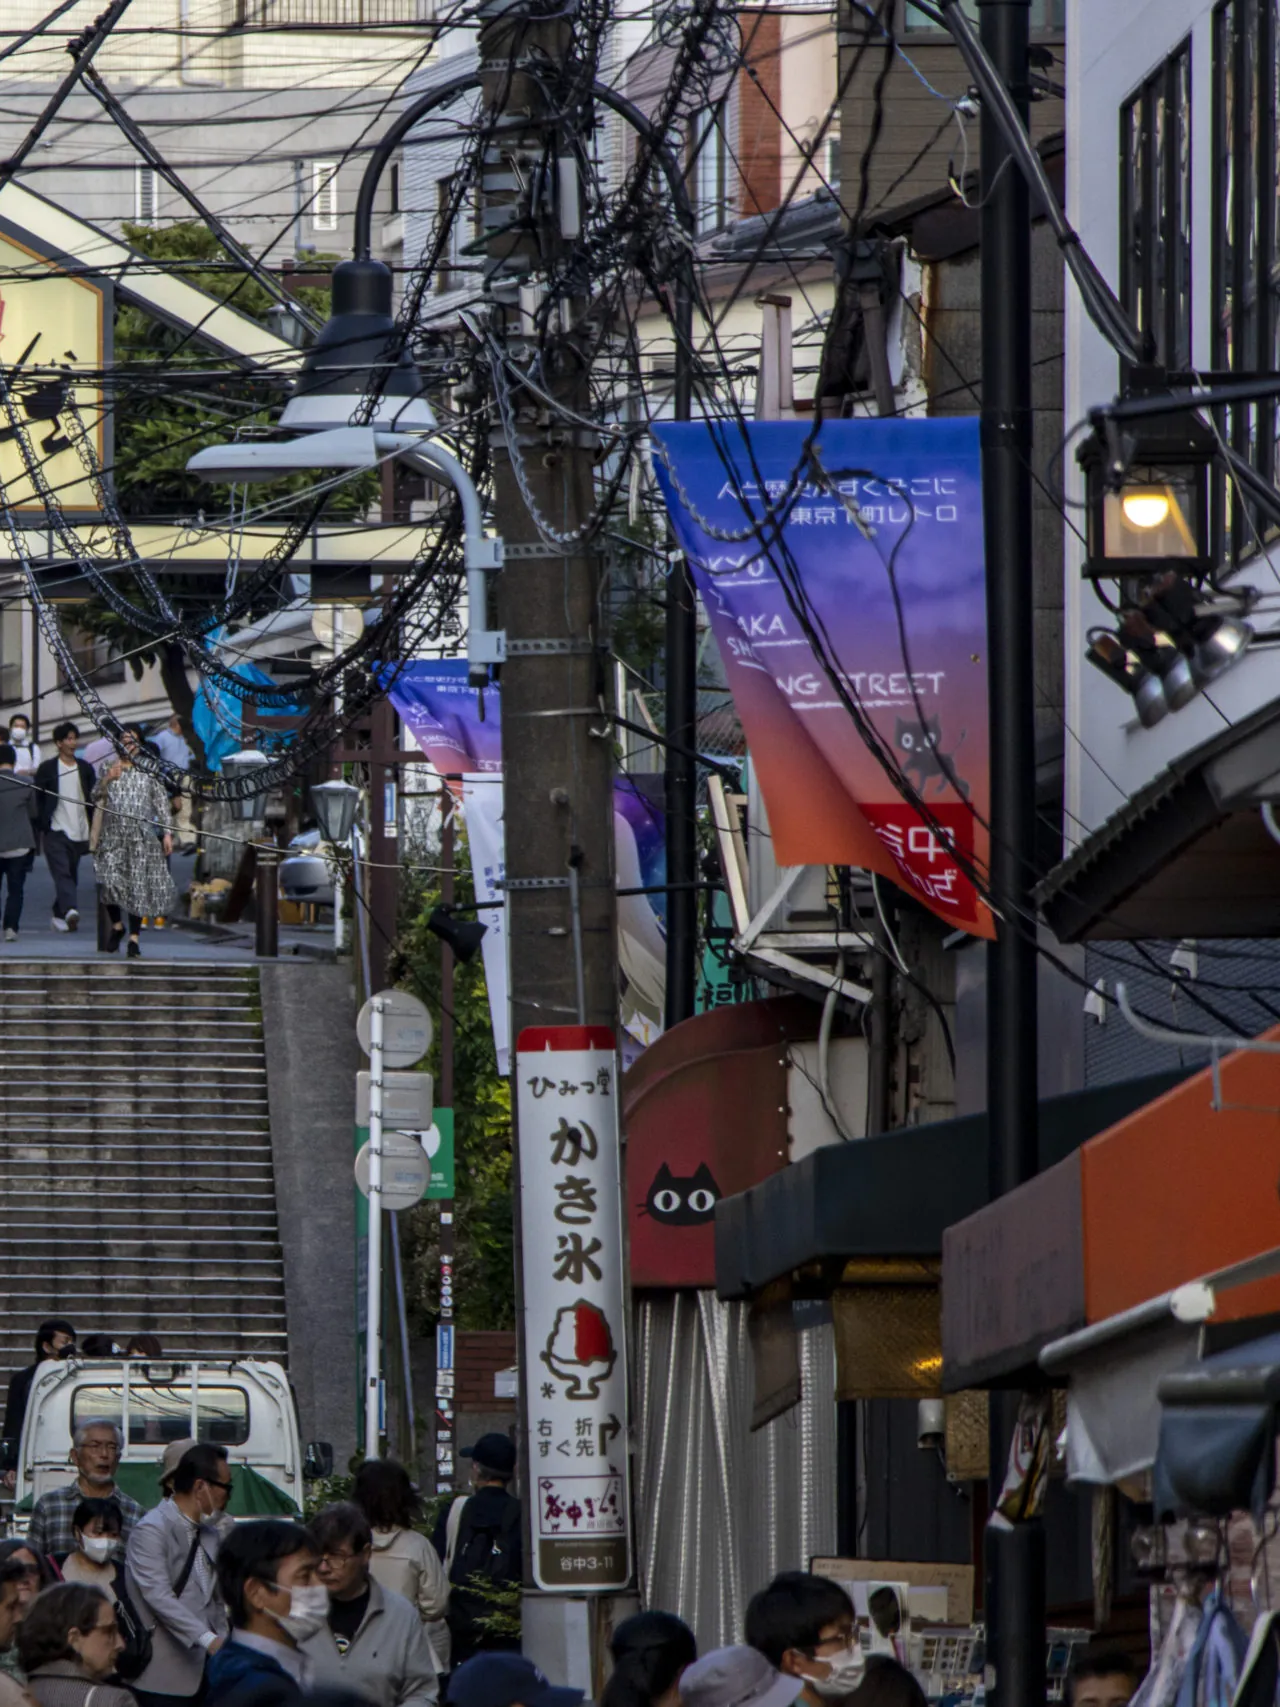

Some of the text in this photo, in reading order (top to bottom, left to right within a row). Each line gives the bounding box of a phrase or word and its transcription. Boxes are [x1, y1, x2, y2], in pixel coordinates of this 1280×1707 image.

[790, 504, 958, 525] 東京下町レトロ
[527, 1067, 610, 1099] ひみつ堂
[550, 1116, 603, 1285] かき氷
[537, 1440, 595, 1458] すぐ先
[560, 1556, 614, 1571] 谷中3-11
